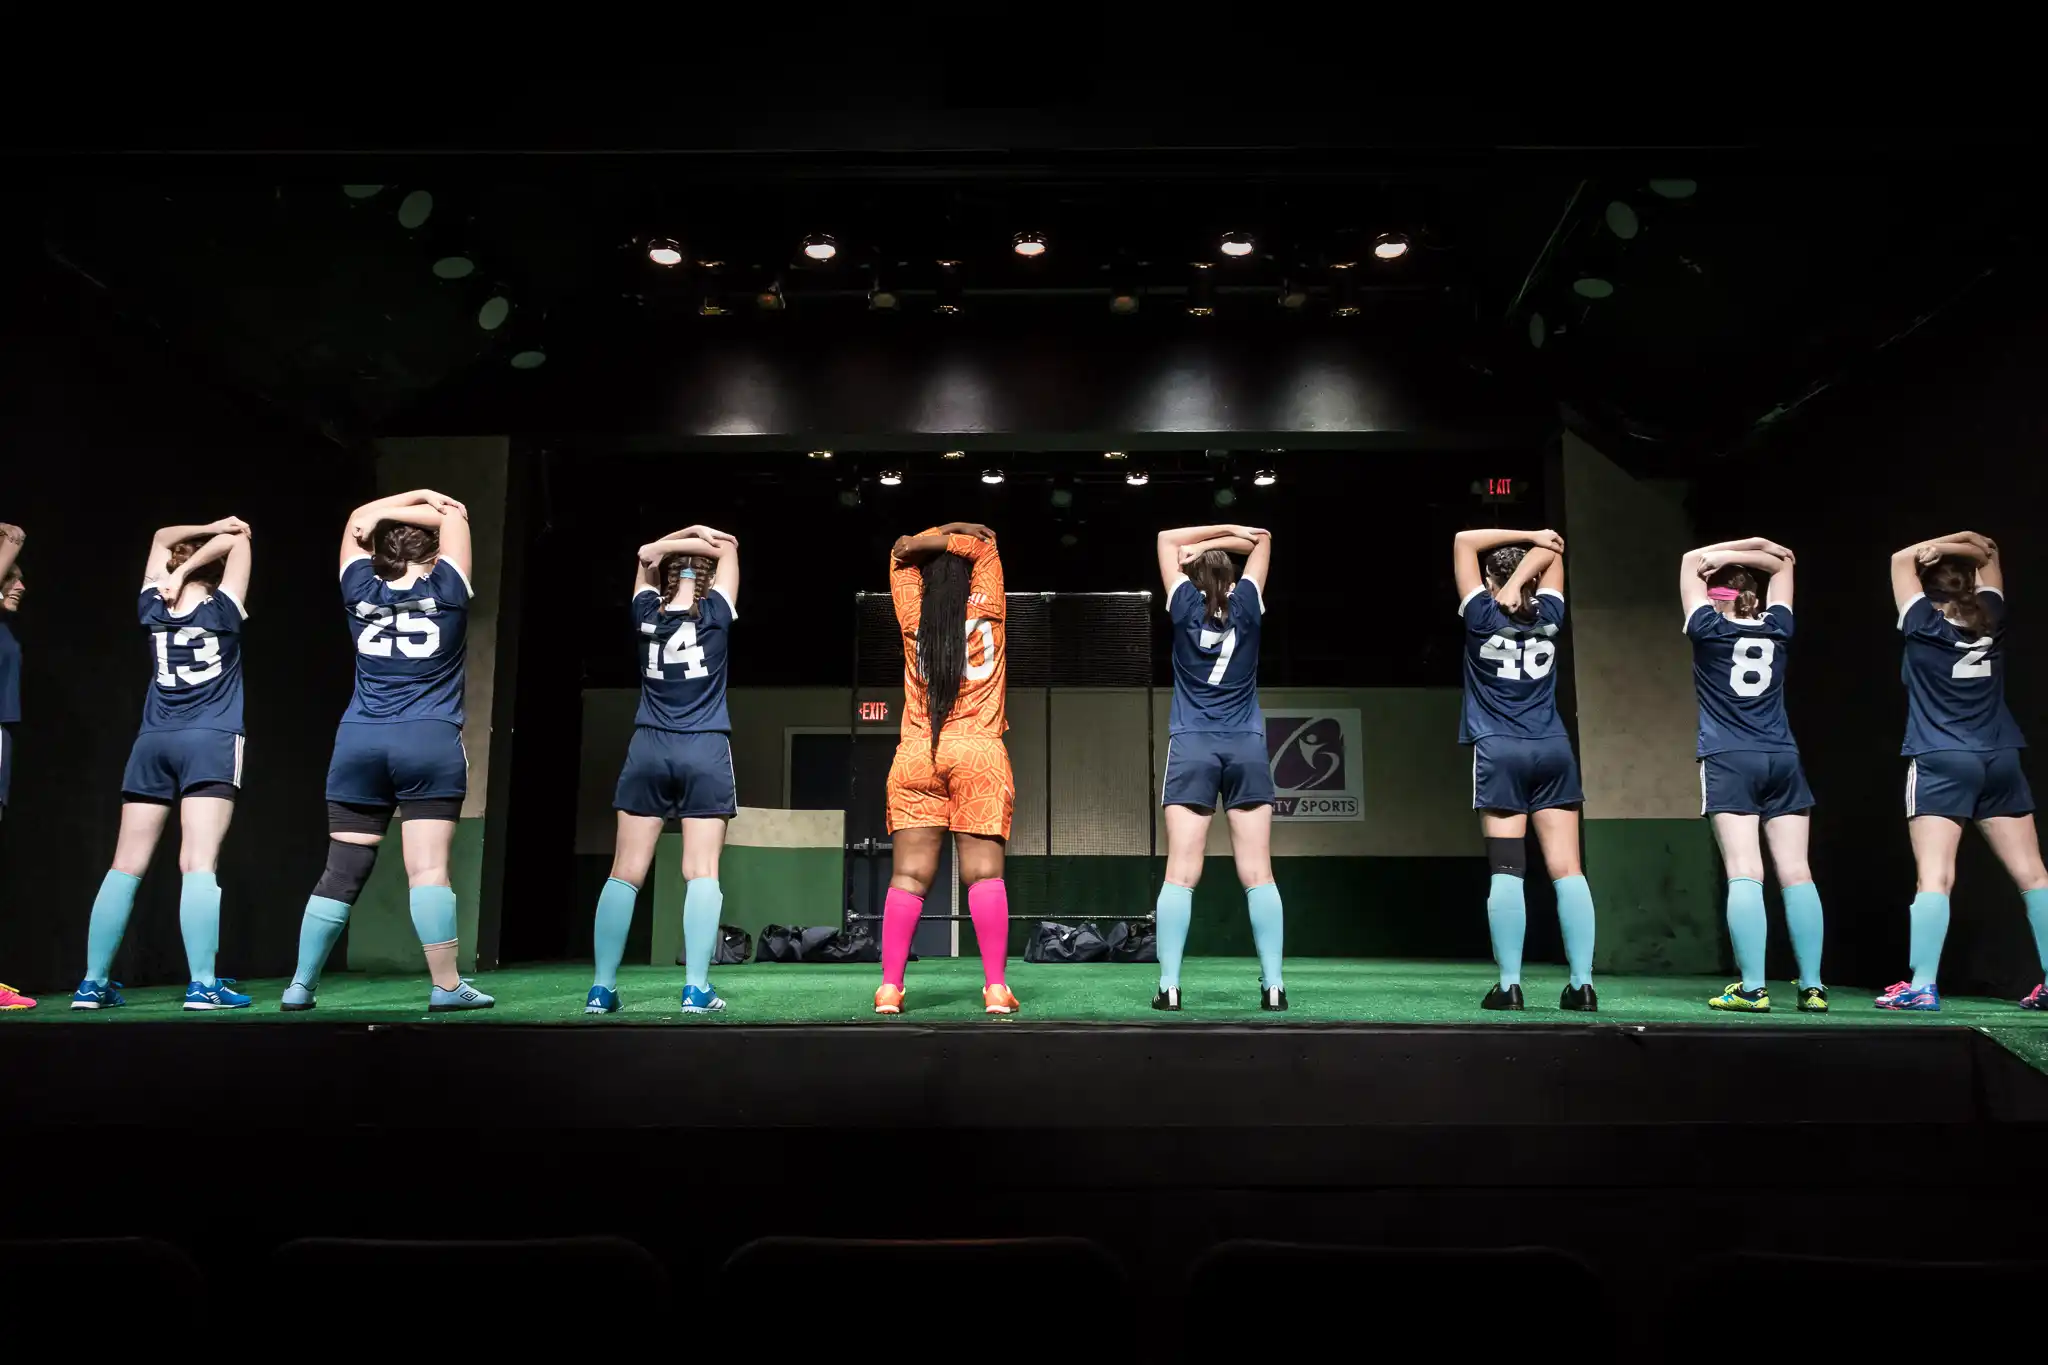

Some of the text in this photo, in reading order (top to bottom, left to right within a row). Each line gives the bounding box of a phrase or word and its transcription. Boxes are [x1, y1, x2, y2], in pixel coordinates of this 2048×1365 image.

[152, 625, 222, 688] 13
[356, 598, 440, 658] 25
[640, 622, 709, 679] 14
[1199, 628, 1236, 685] 7
[1479, 624, 1557, 681] 46
[1730, 637, 1775, 697] 8
[1952, 637, 1993, 679] 2
[862, 702, 886, 720] EXIT
[1301, 800, 1355, 812] SPORTS
